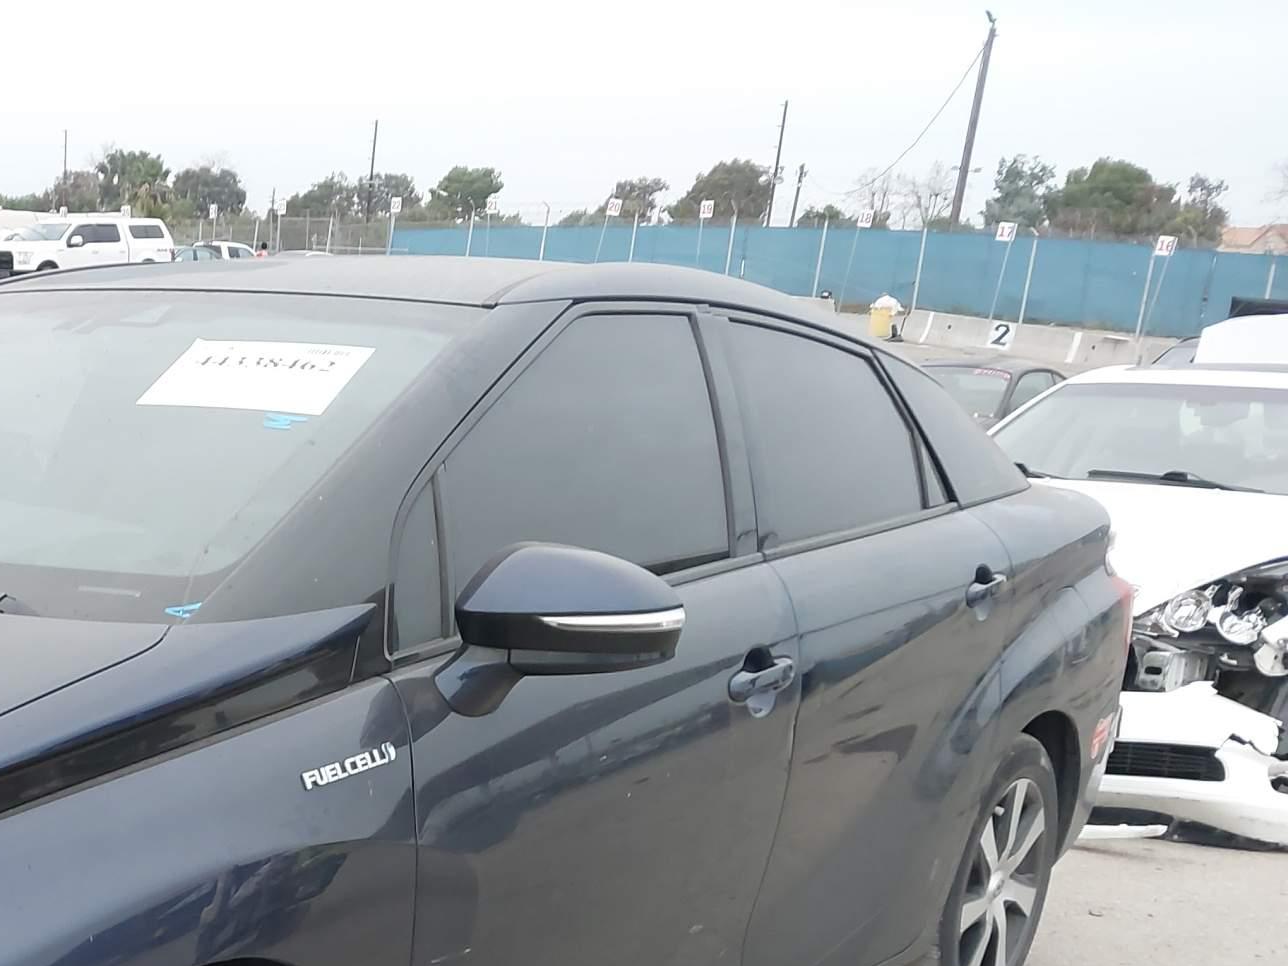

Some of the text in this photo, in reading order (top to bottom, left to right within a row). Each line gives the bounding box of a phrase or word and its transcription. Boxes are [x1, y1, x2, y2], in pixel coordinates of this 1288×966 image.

[859, 212, 872, 224] 18
[998, 225, 1013, 238] 17
[1158, 239, 1173, 251] 16
[991, 323, 1010, 346] 2
